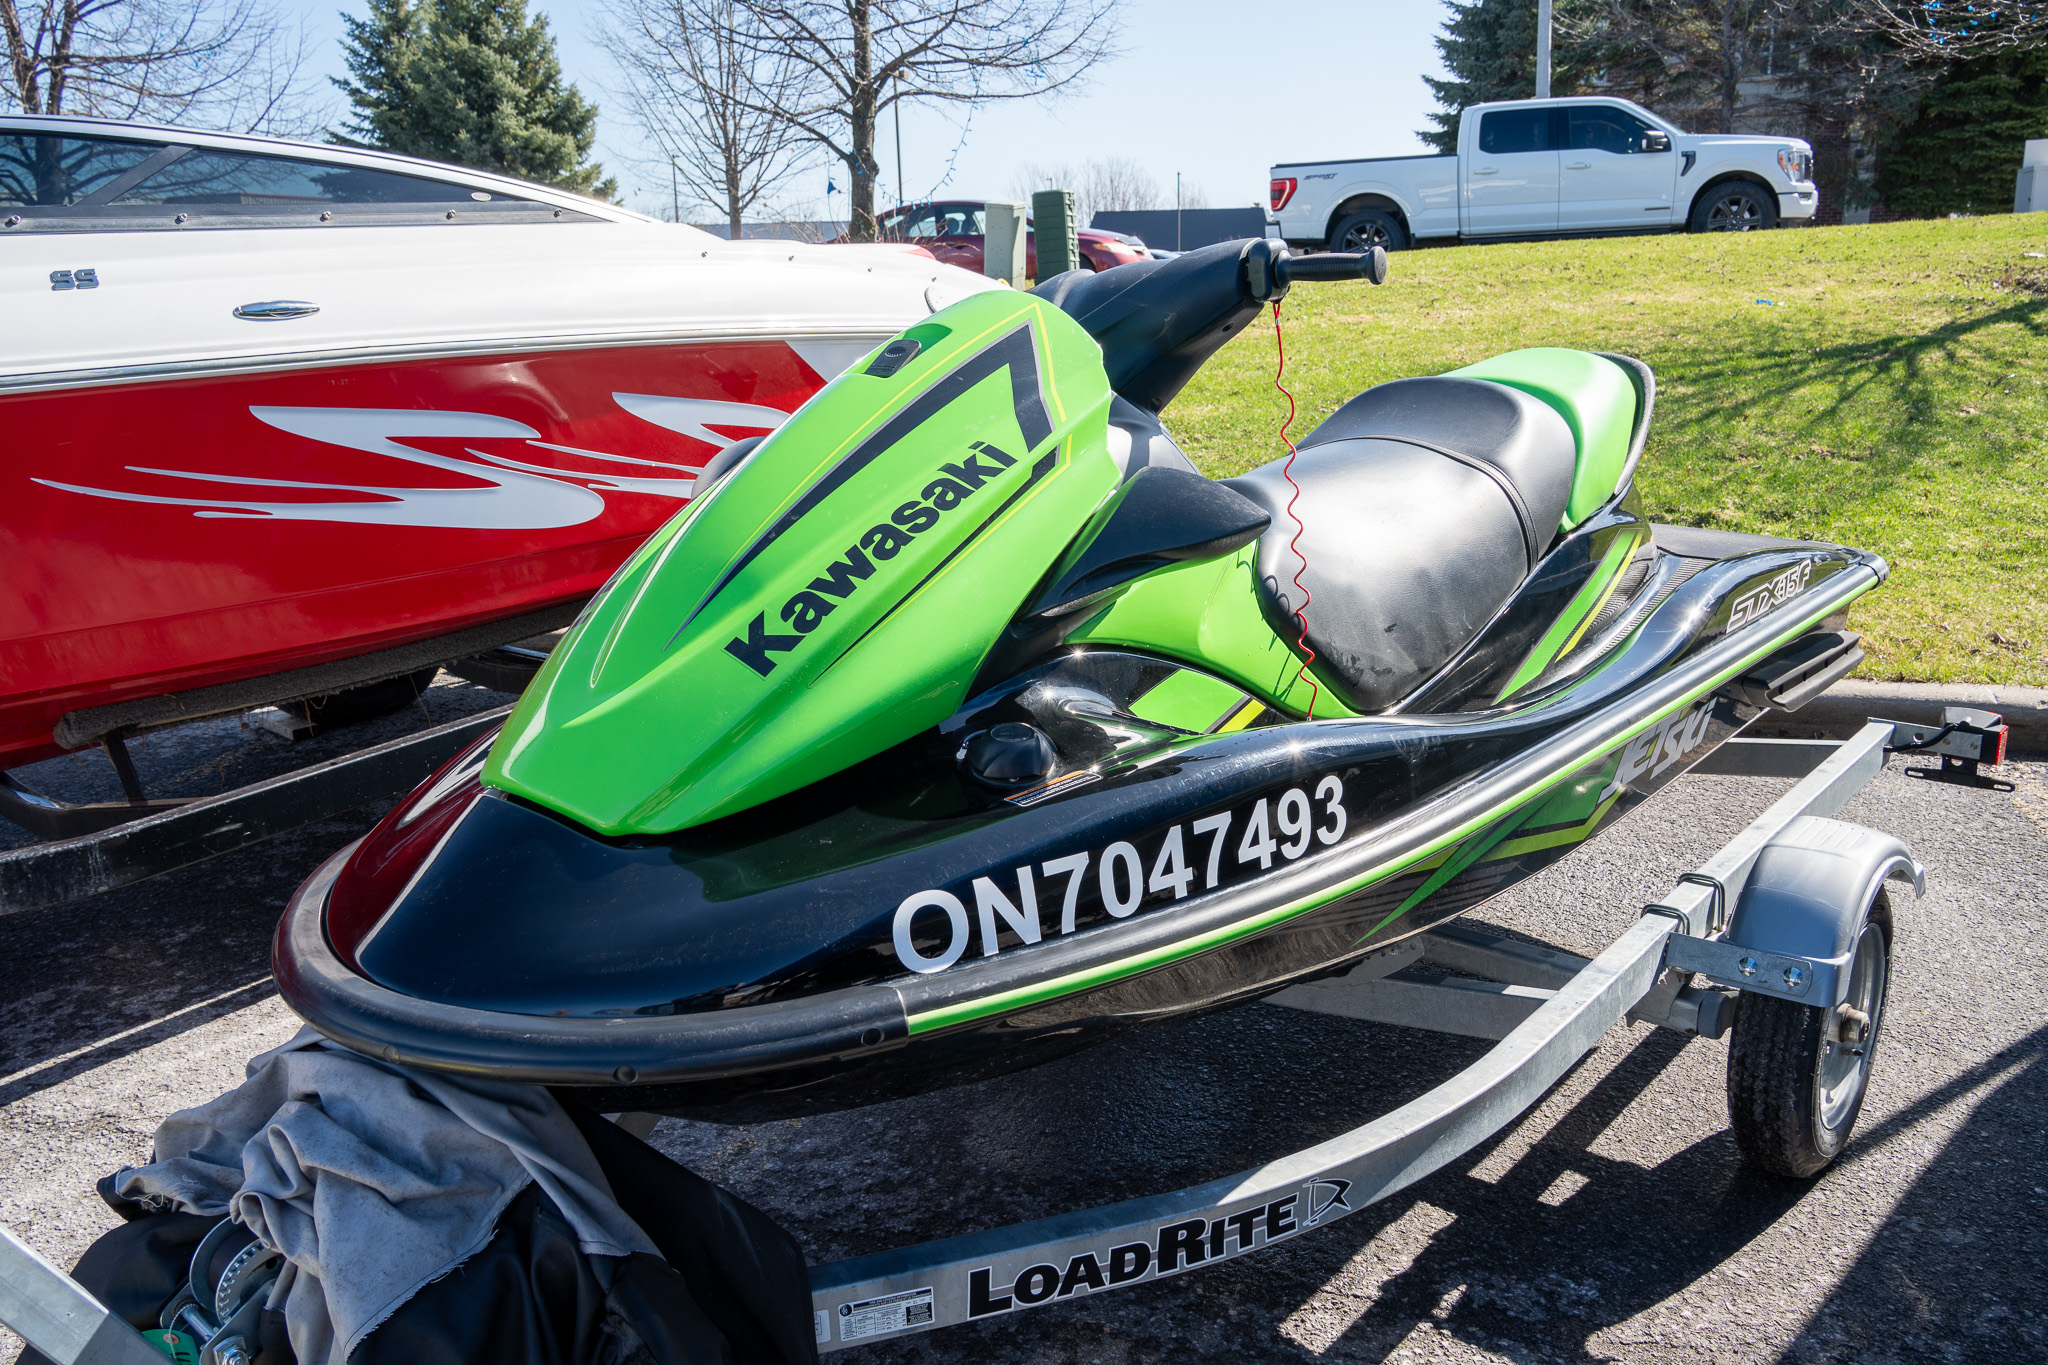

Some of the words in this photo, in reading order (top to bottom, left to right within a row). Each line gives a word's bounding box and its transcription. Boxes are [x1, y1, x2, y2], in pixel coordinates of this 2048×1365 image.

[49, 268, 99, 291] SS
[723, 440, 1018, 678] Kawasaki
[892, 775, 1347, 974] ON7047493
